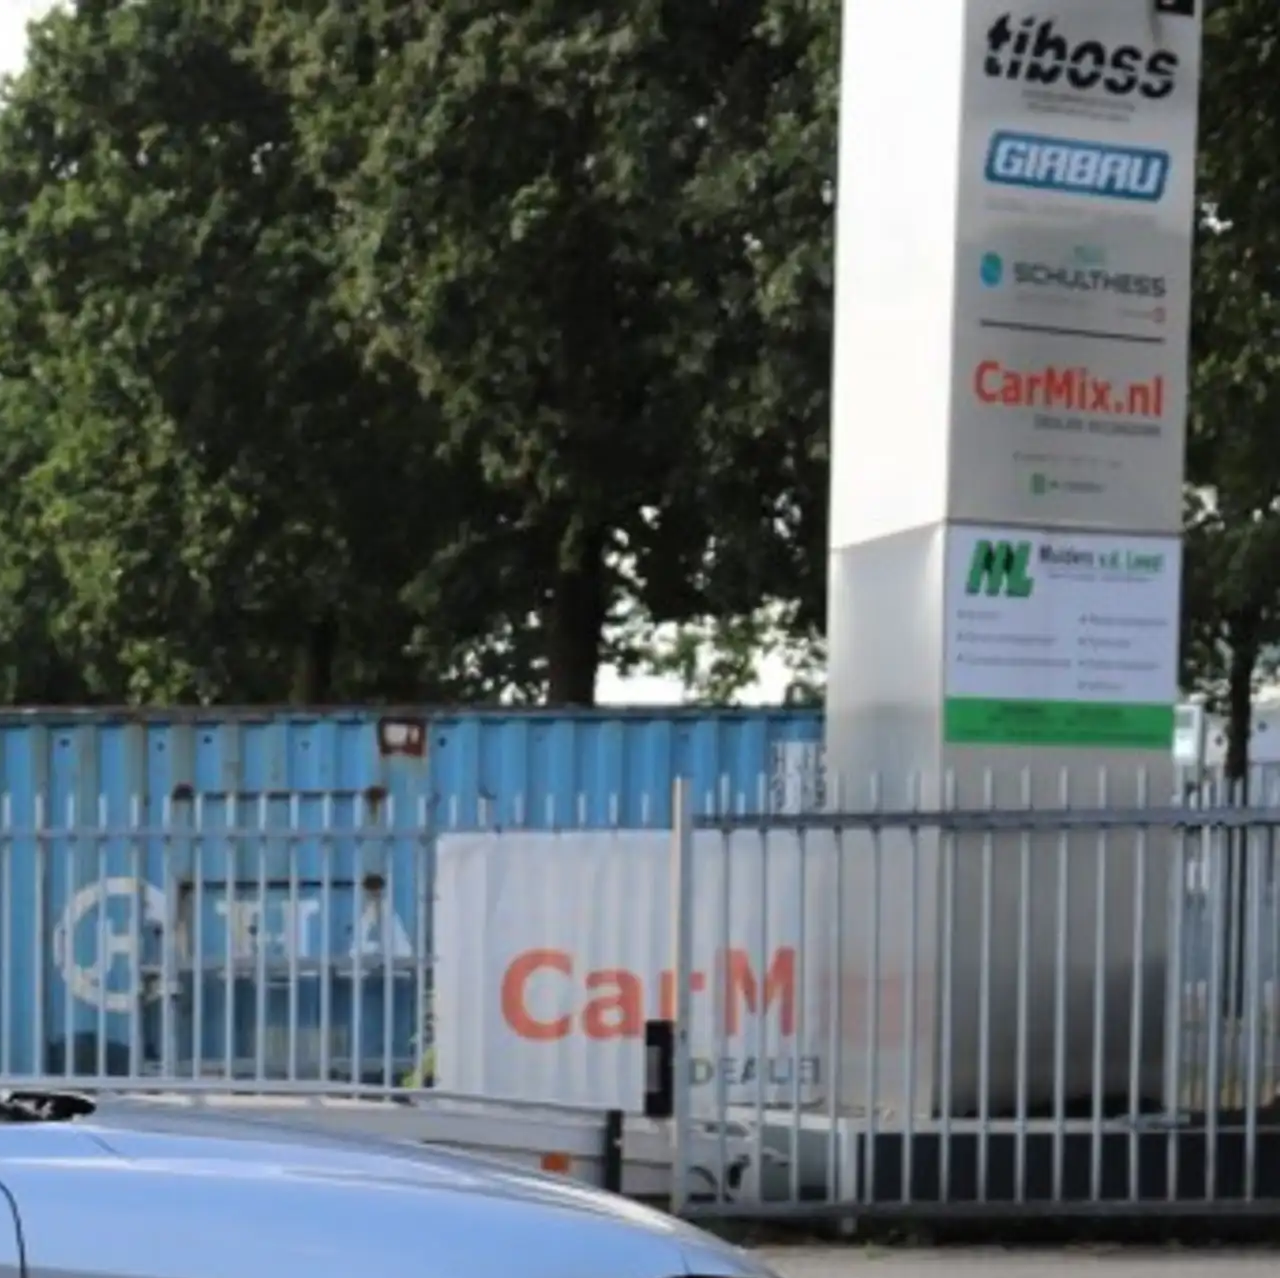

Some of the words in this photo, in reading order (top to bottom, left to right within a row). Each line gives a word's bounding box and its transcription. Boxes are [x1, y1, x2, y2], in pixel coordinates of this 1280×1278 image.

[984, 12, 1179, 99] tiboss
[1014, 261, 1167, 299] SCHULTHESS
[975, 360, 1163, 417] CarMix.nl
